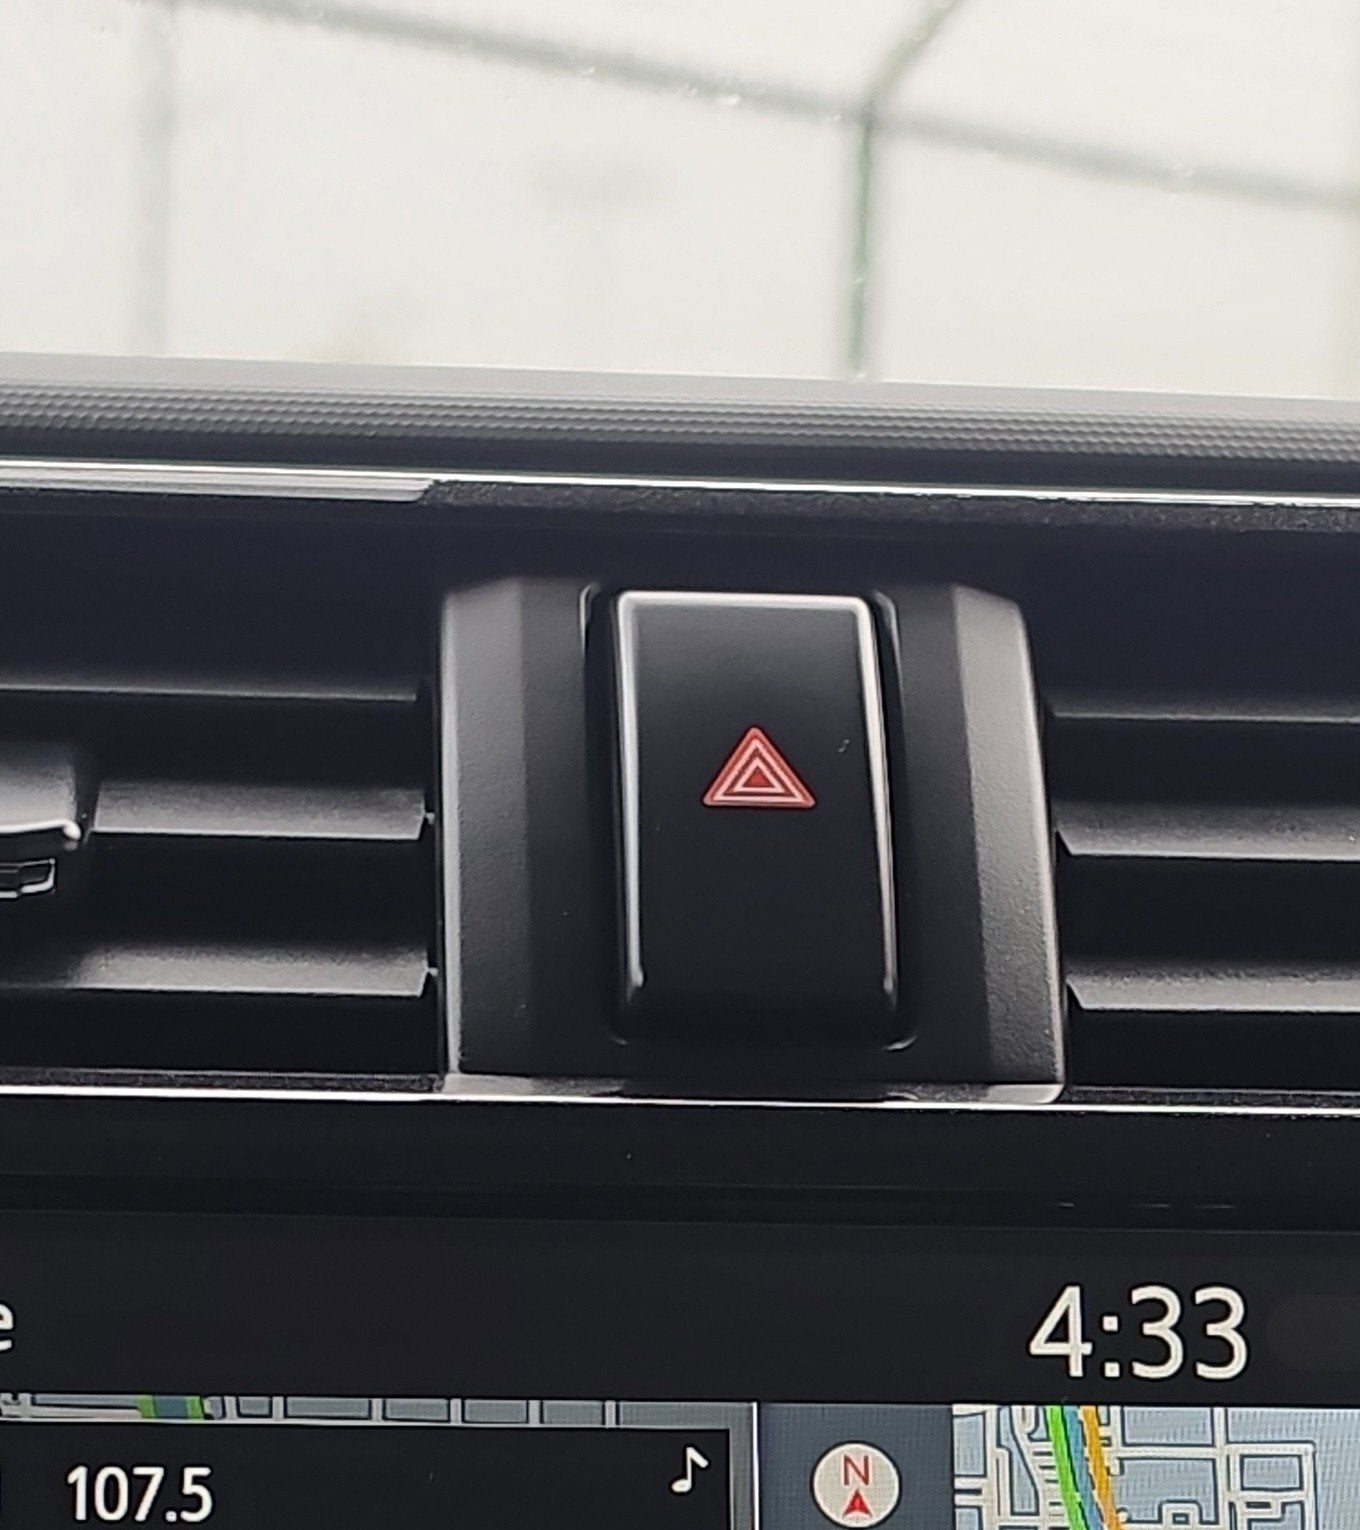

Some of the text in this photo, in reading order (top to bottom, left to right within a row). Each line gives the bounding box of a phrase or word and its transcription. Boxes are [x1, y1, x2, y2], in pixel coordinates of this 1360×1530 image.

[1029, 1285, 1248, 1379] 4:33
[67, 1465, 213, 1522] 107.5
[843, 1455, 870, 1485] N
